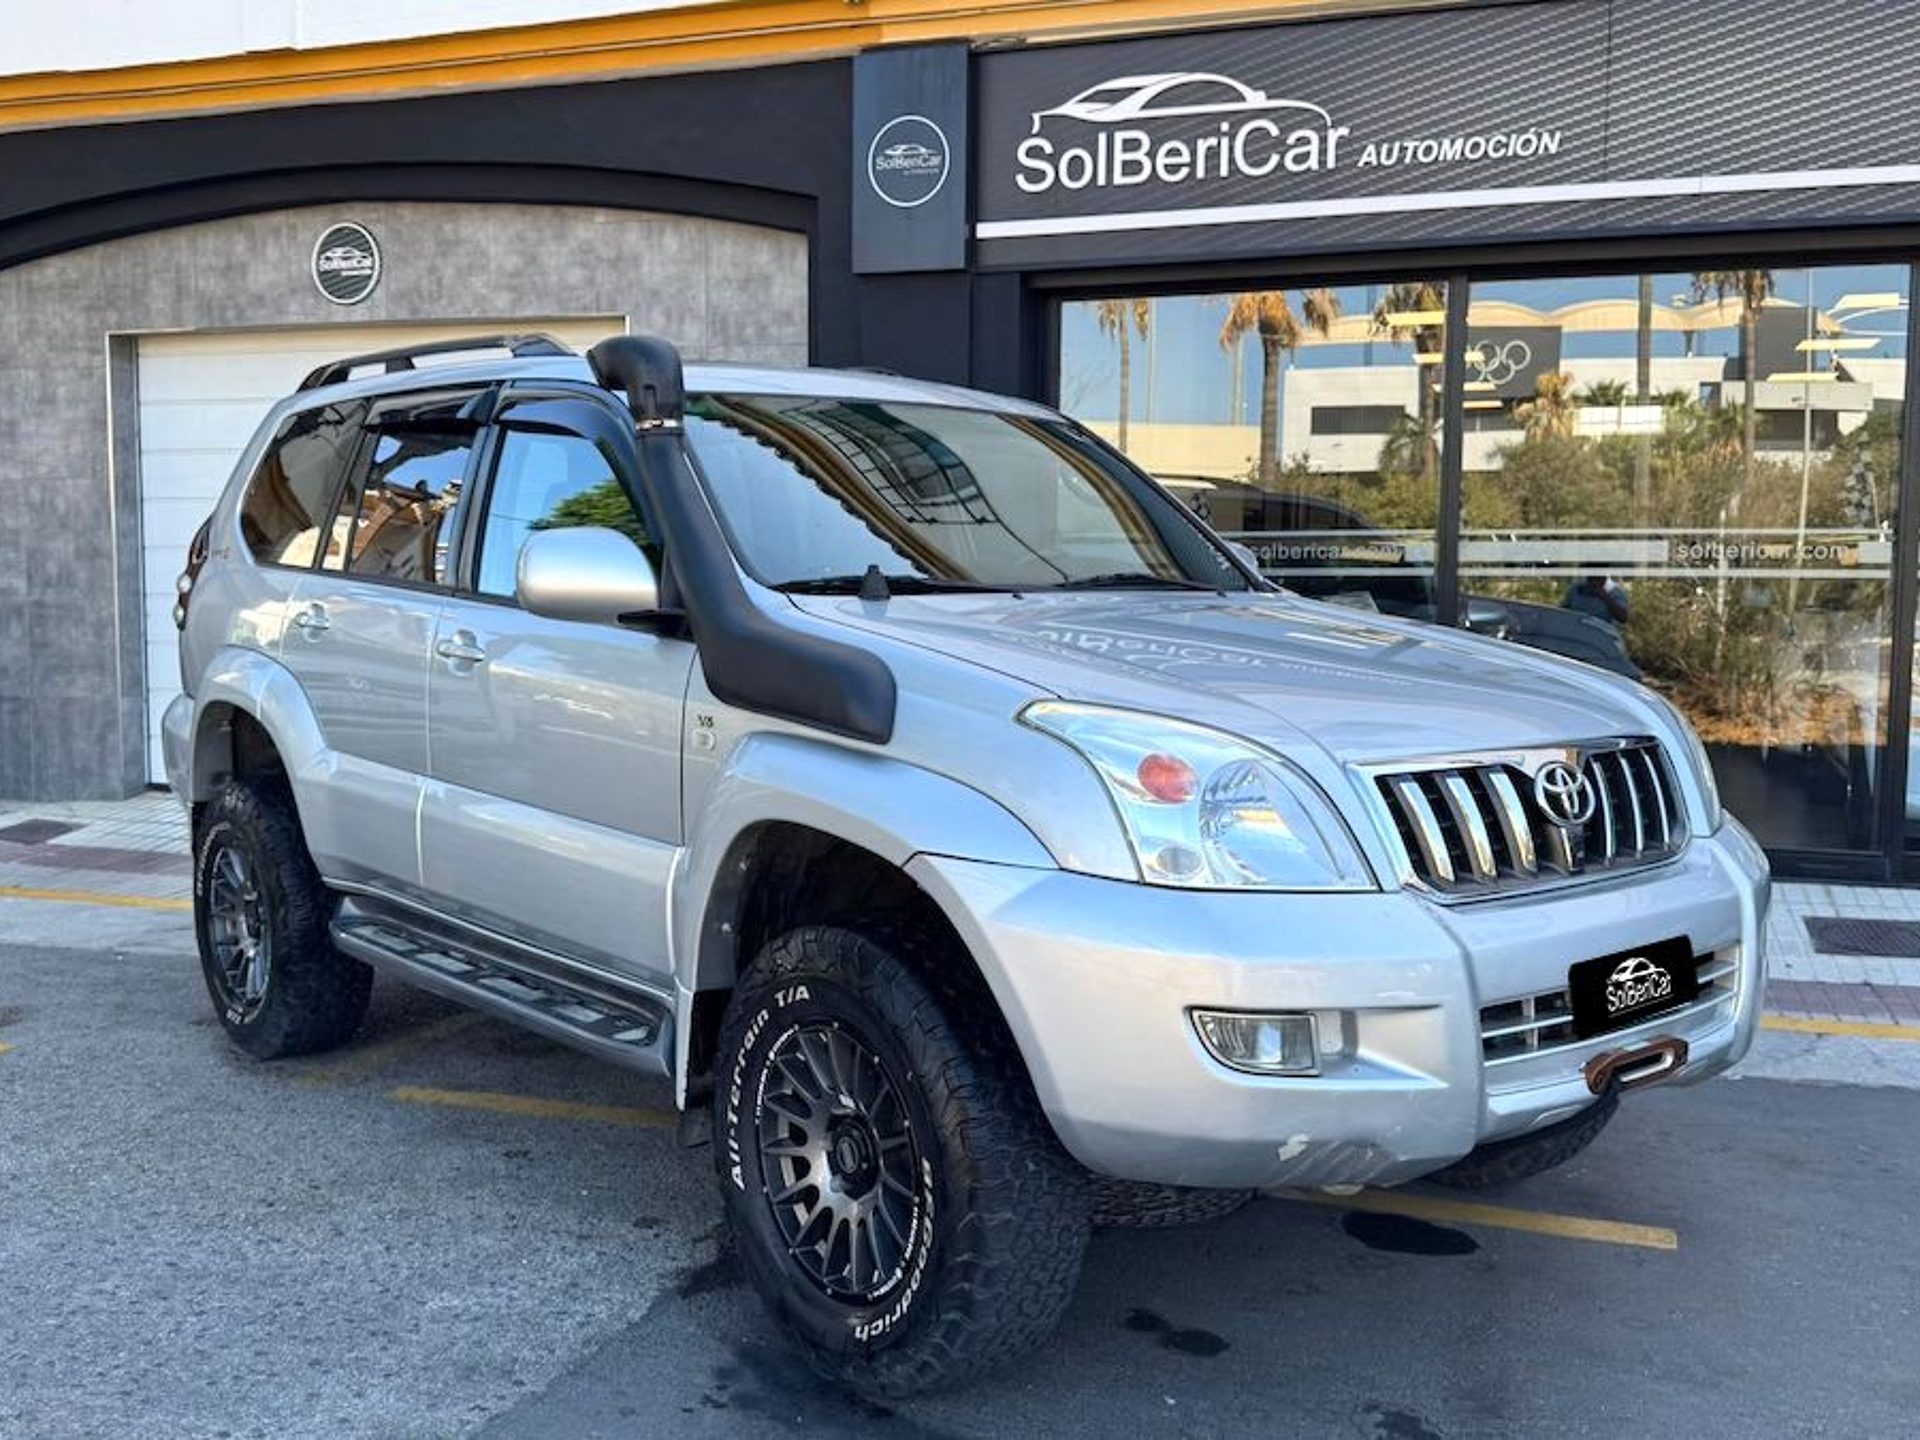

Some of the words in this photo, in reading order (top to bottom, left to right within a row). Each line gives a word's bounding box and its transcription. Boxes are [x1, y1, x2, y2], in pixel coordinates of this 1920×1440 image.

[1015, 119, 1349, 193] SolBeriCar
[1357, 127, 1562, 168] AUTOMOCIÓN
[774, 984, 810, 1008] T/A
